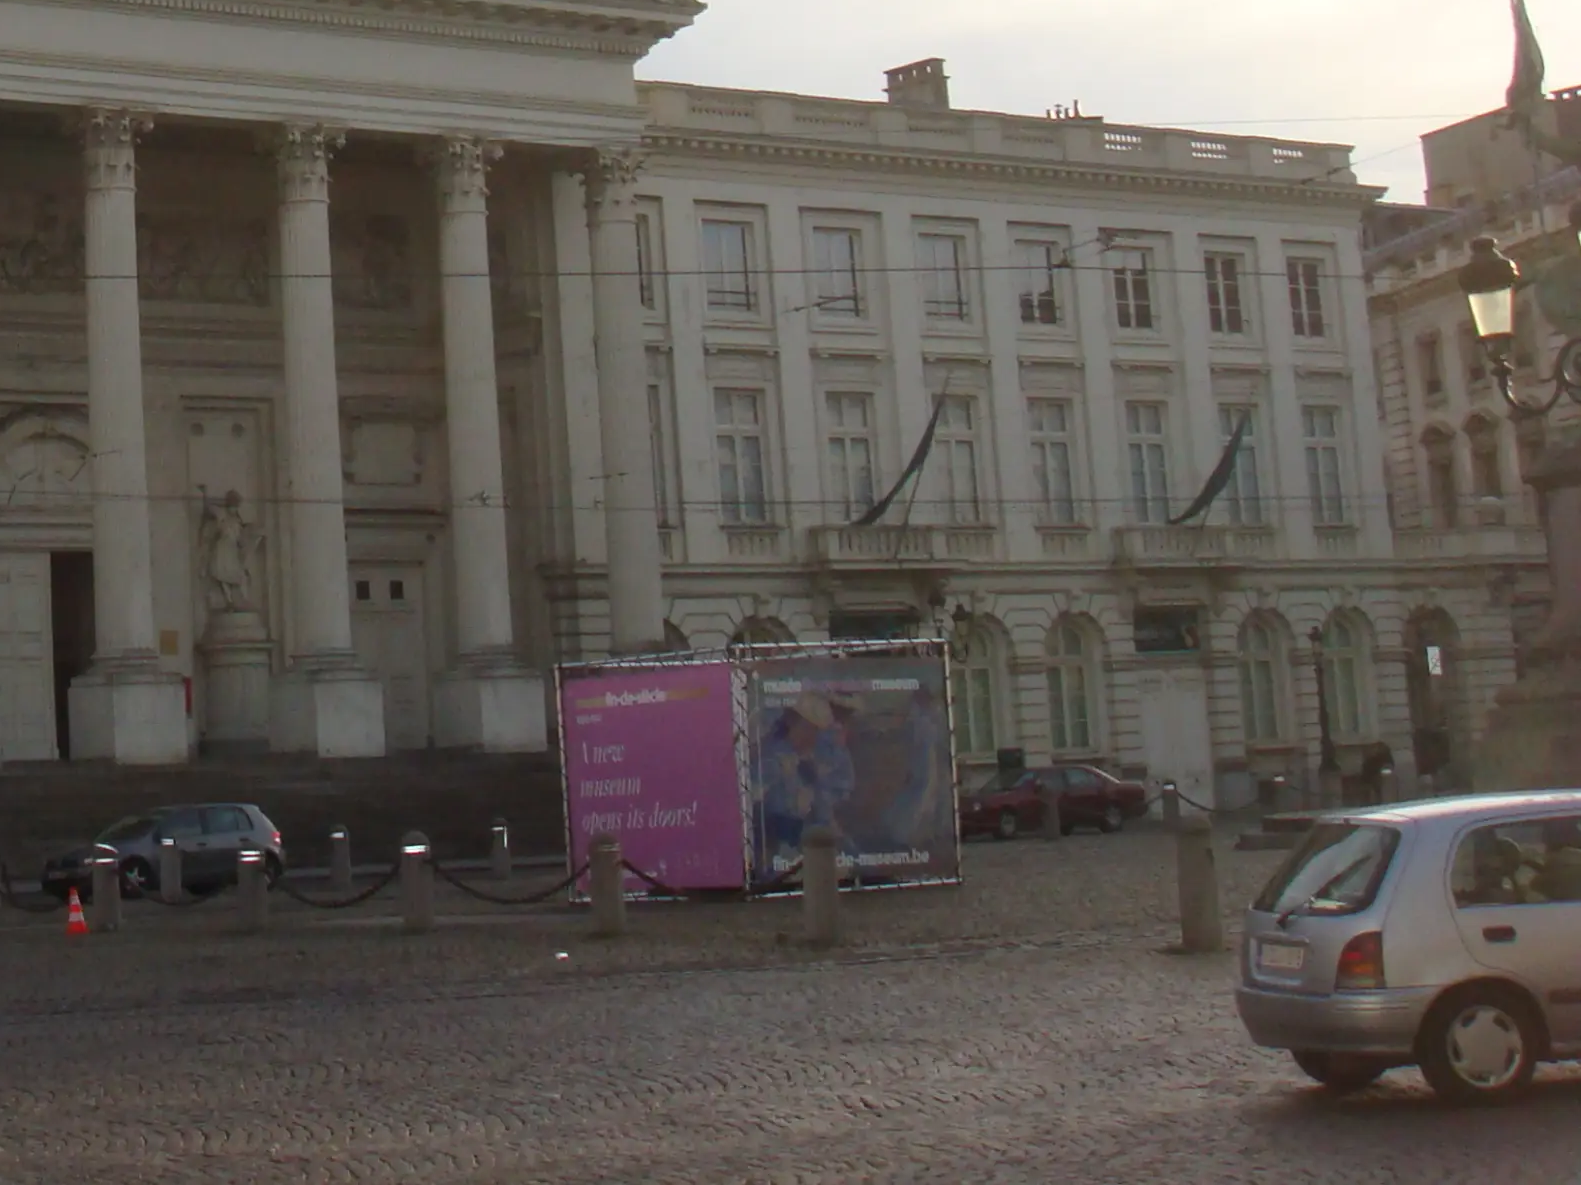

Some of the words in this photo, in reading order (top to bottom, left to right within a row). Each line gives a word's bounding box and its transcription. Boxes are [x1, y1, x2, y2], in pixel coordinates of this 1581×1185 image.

[592, 743, 626, 765] new
[581, 776, 641, 799] museum
[581, 810, 624, 836] opens
[626, 803, 647, 830] its
[649, 800, 698, 830] doors!
